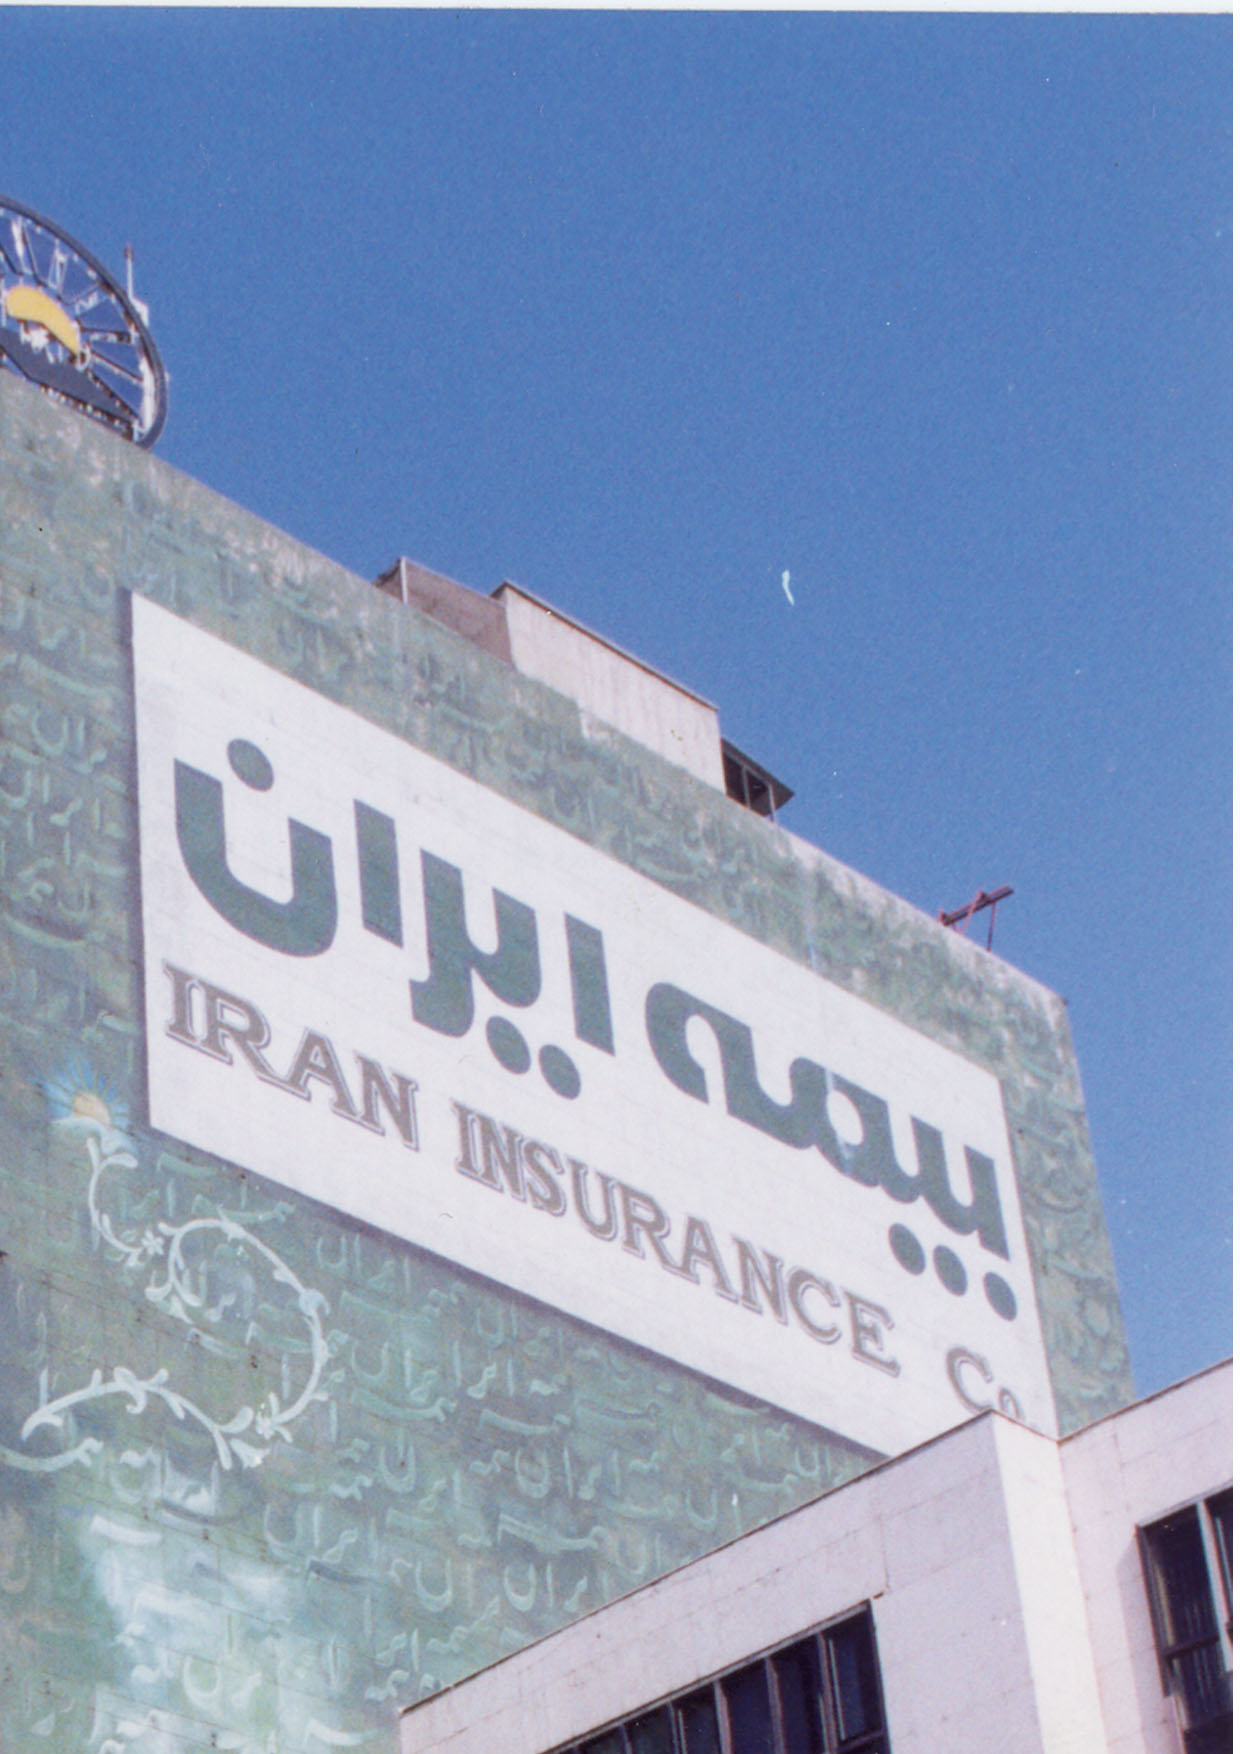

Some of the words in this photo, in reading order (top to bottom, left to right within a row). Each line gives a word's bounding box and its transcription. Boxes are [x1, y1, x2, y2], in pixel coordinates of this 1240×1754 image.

[173, 738, 616, 1099] ایران
[161, 962, 421, 1150] IRAN
[451, 1098, 902, 1378] INSURANCE
[644, 981, 1018, 1322] بیمه
